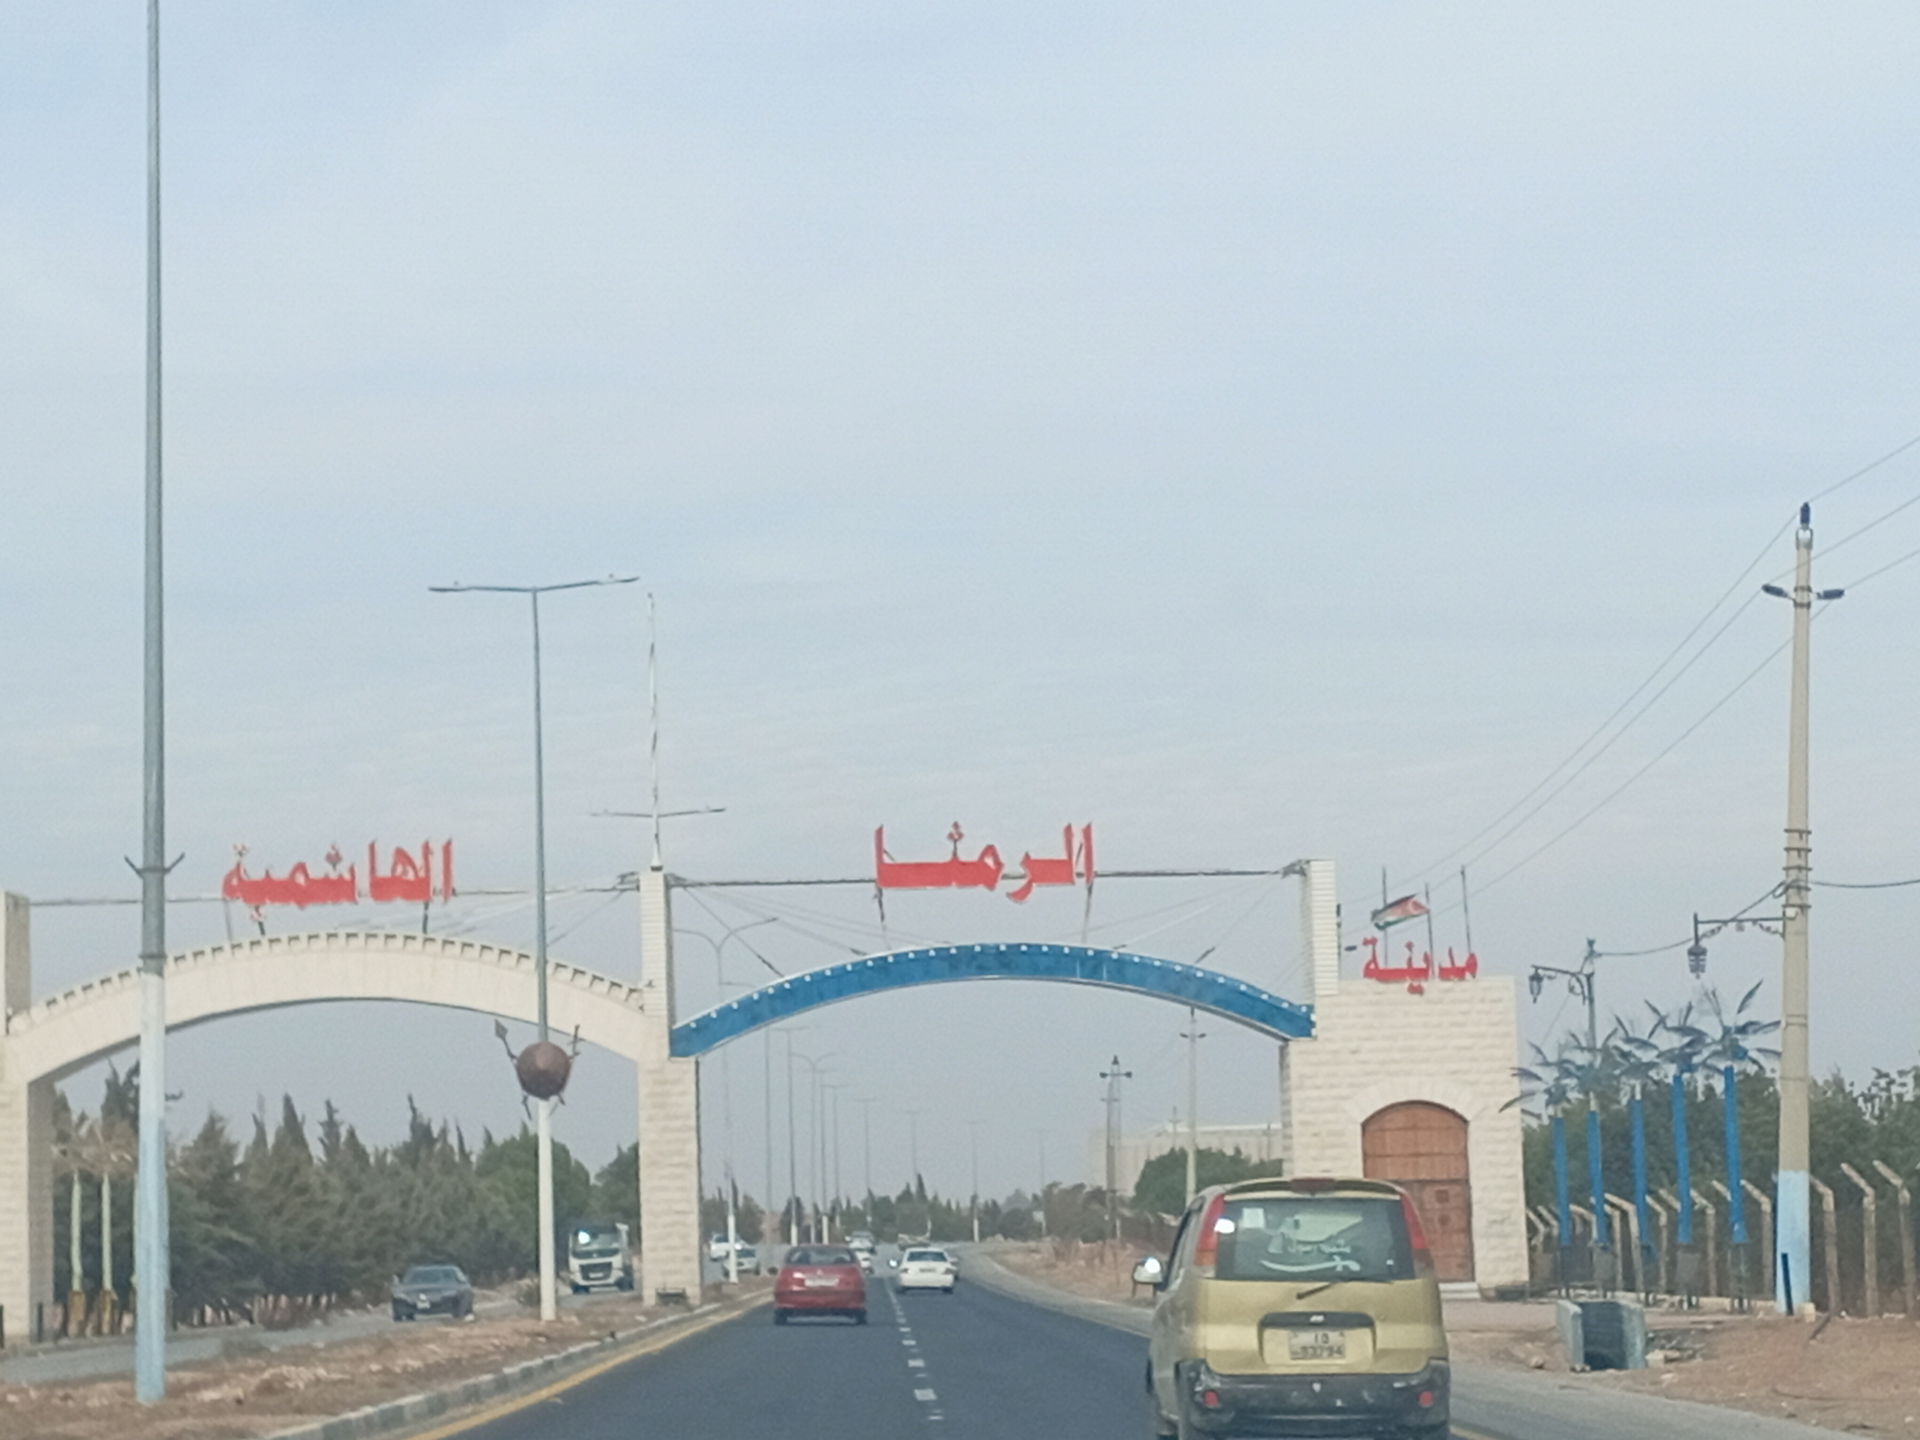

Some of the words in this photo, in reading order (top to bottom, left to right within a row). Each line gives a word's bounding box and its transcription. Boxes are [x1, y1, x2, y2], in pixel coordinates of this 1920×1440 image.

[222, 839, 454, 921] الهاشمية
[874, 821, 1093, 904] الرمثا
[1362, 936, 1478, 996] مدينة
